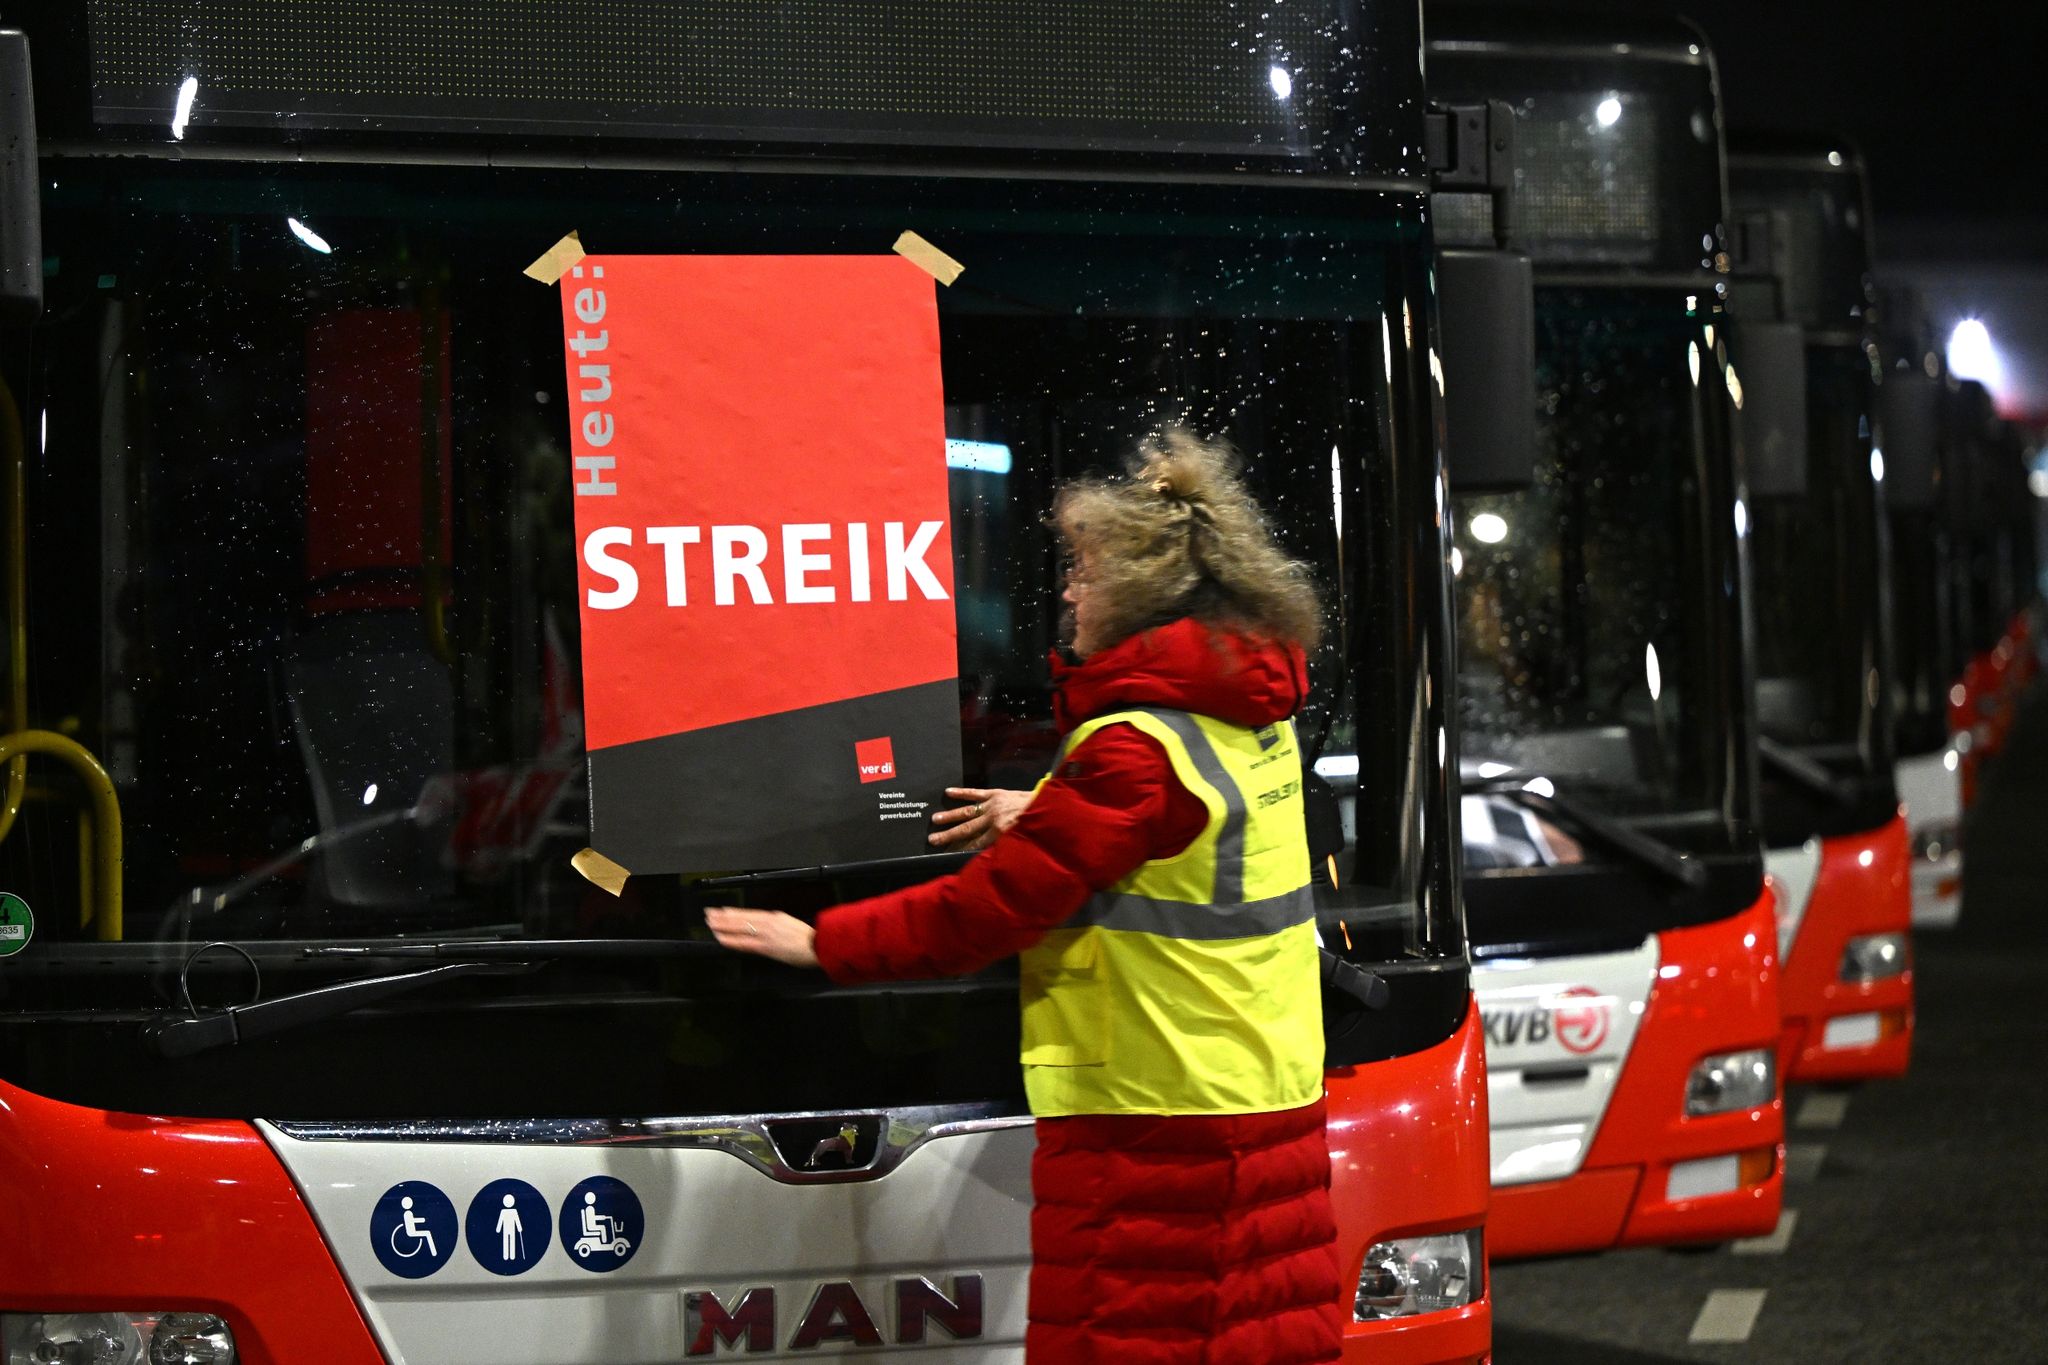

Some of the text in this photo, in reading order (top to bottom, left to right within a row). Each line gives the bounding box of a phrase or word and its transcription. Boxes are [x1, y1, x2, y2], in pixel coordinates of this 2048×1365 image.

[568, 265, 617, 496] Heute:
[583, 520, 950, 610] STREIK
[879, 801, 928, 809] Dienstleistungs-
[880, 811, 922, 821] gewerkschaft
[1482, 1009, 1549, 1045] KVB
[680, 1270, 985, 1357] MAN
